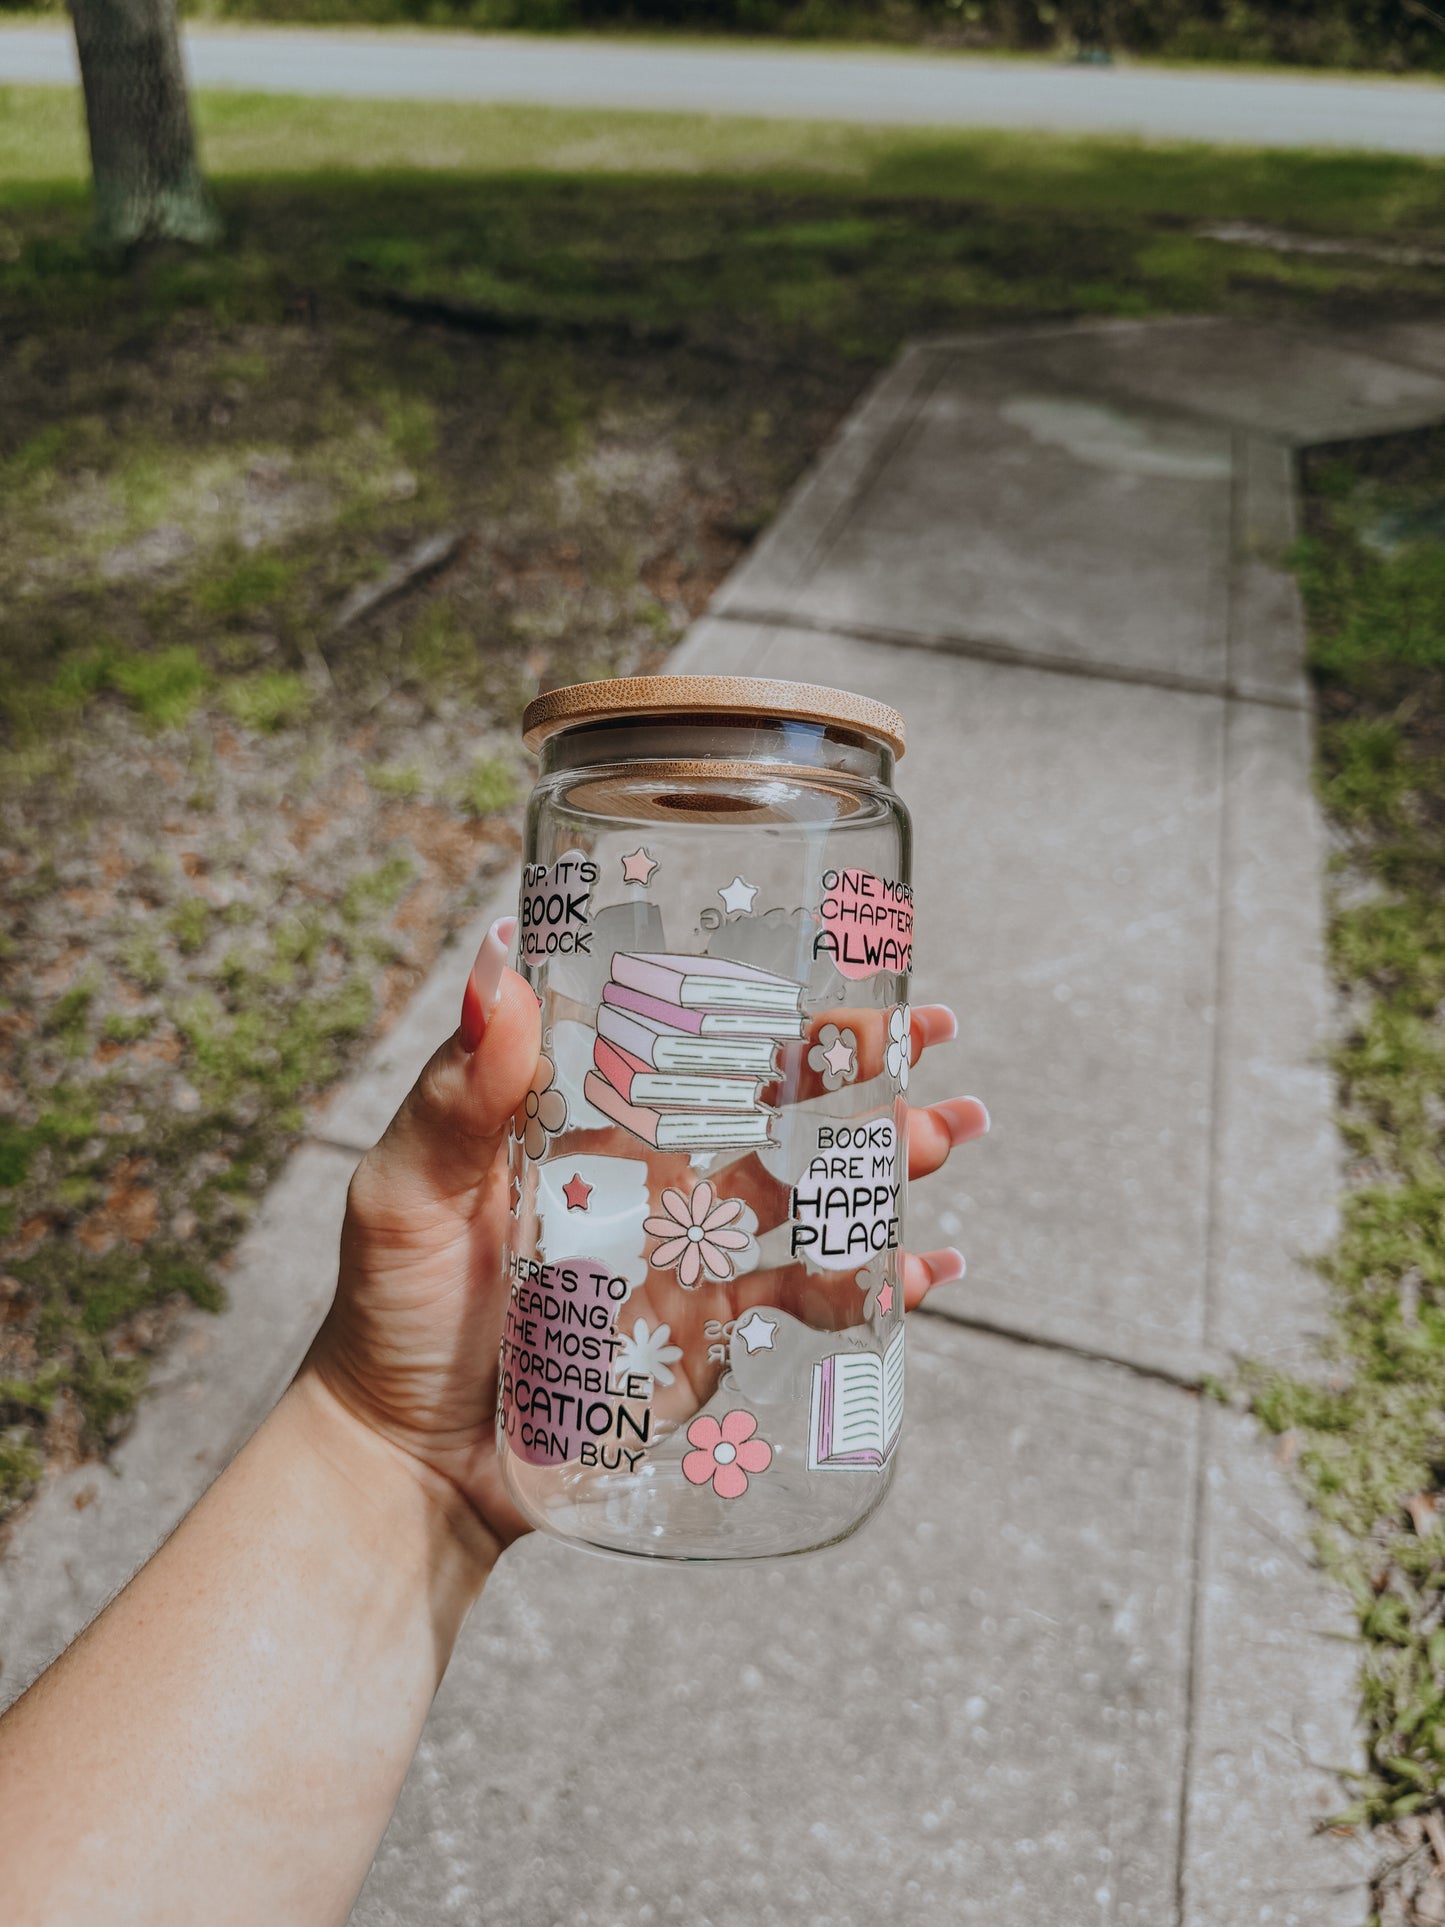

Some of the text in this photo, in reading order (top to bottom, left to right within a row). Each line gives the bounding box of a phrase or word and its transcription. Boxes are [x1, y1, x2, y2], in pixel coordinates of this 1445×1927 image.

[555, 862, 597, 882] IT'S
[822, 870, 875, 897] ONE
[522, 893, 590, 927] BOOK
[818, 1127, 892, 1149] BOOKS
[809, 1155, 895, 1179] ARE MY
[793, 1183, 900, 1219] HAPPY
[791, 1217, 899, 1256] PLACE
[509, 1255, 627, 1300] HERE'S TO
[510, 1284, 615, 1335] READING,
[507, 1311, 622, 1363] THE MOST
[521, 1422, 569, 1461] CAN
[580, 1441, 645, 1473] BUY
